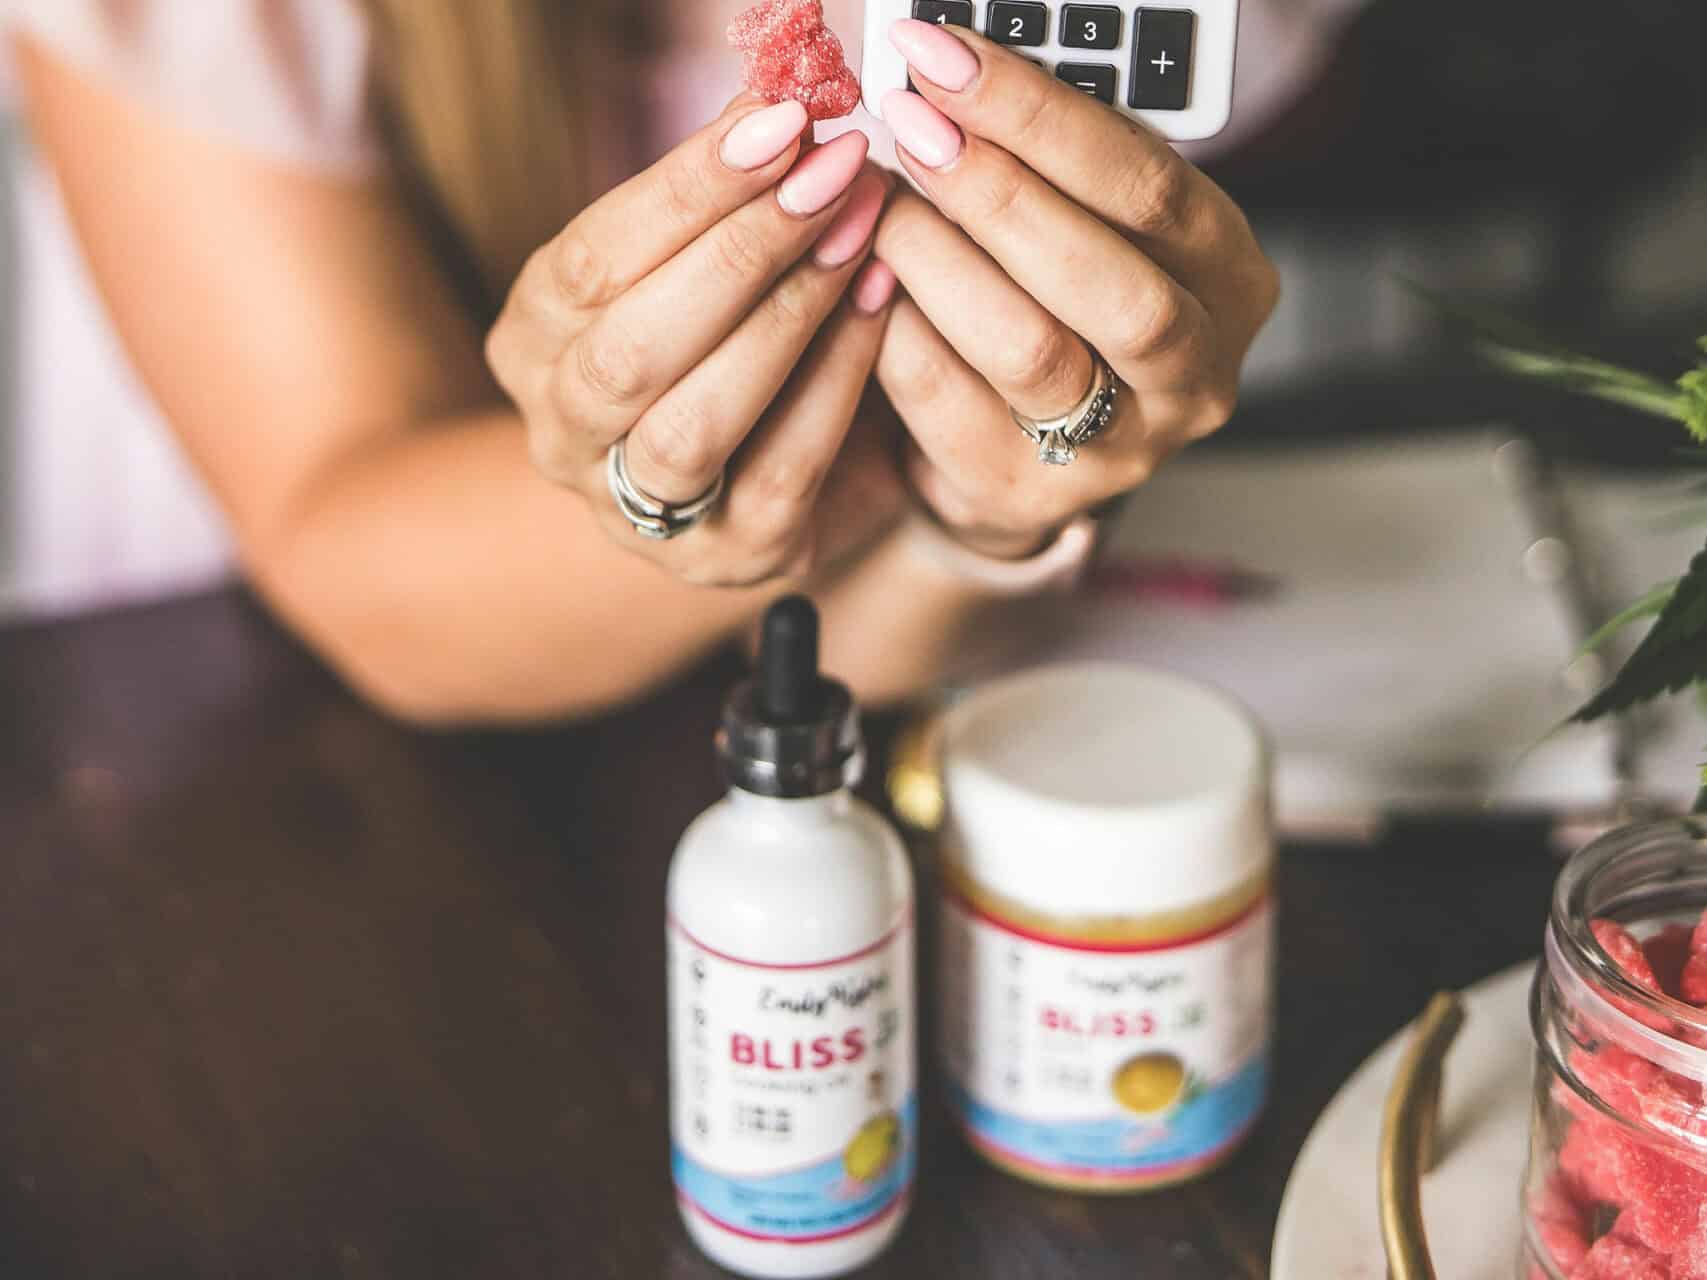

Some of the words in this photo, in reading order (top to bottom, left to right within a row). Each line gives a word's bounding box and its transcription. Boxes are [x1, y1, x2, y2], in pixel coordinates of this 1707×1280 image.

[1009, 18, 1023, 37] 2
[1084, 22, 1096, 40] 3
[730, 1028, 866, 1070] BLISS
